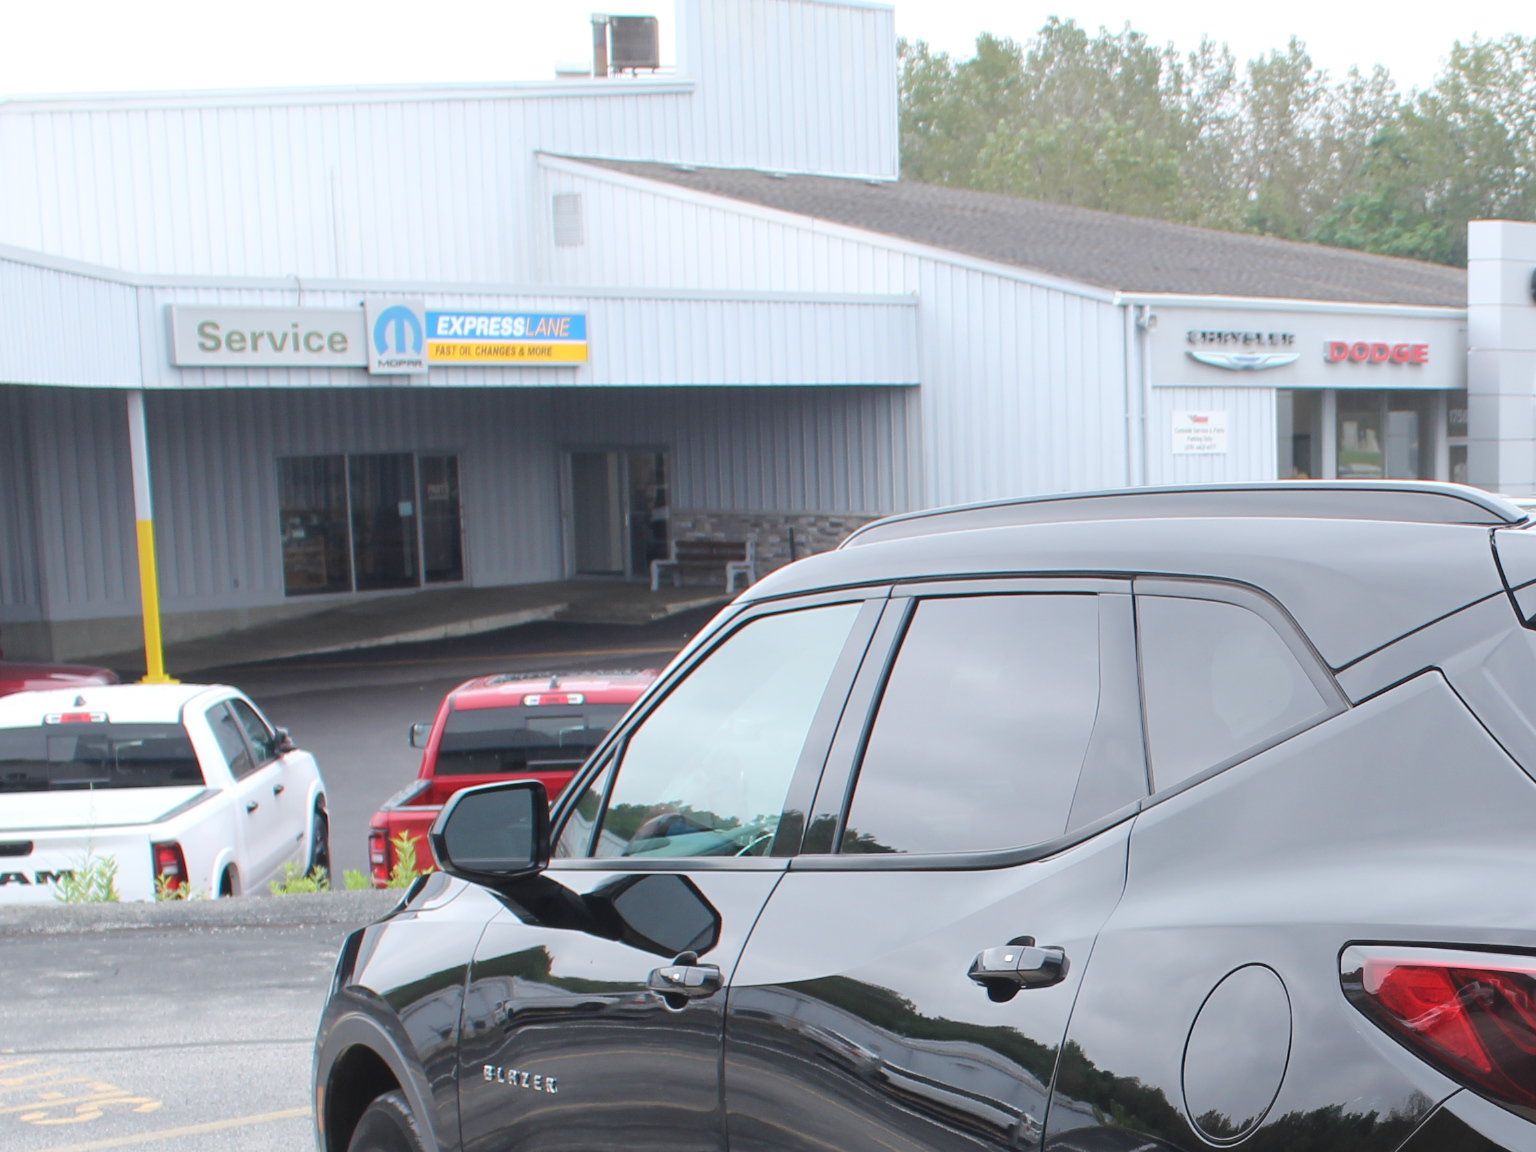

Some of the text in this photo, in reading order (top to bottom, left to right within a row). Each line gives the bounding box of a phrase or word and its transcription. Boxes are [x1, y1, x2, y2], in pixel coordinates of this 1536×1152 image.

[196, 320, 349, 354] Service
[434, 344, 553, 358] FAST OIL CHANGES & MORE
[1326, 341, 1430, 364] DODGE
[377, 359, 423, 368] MOPAR
[483, 1064, 558, 1094] BLAZER
